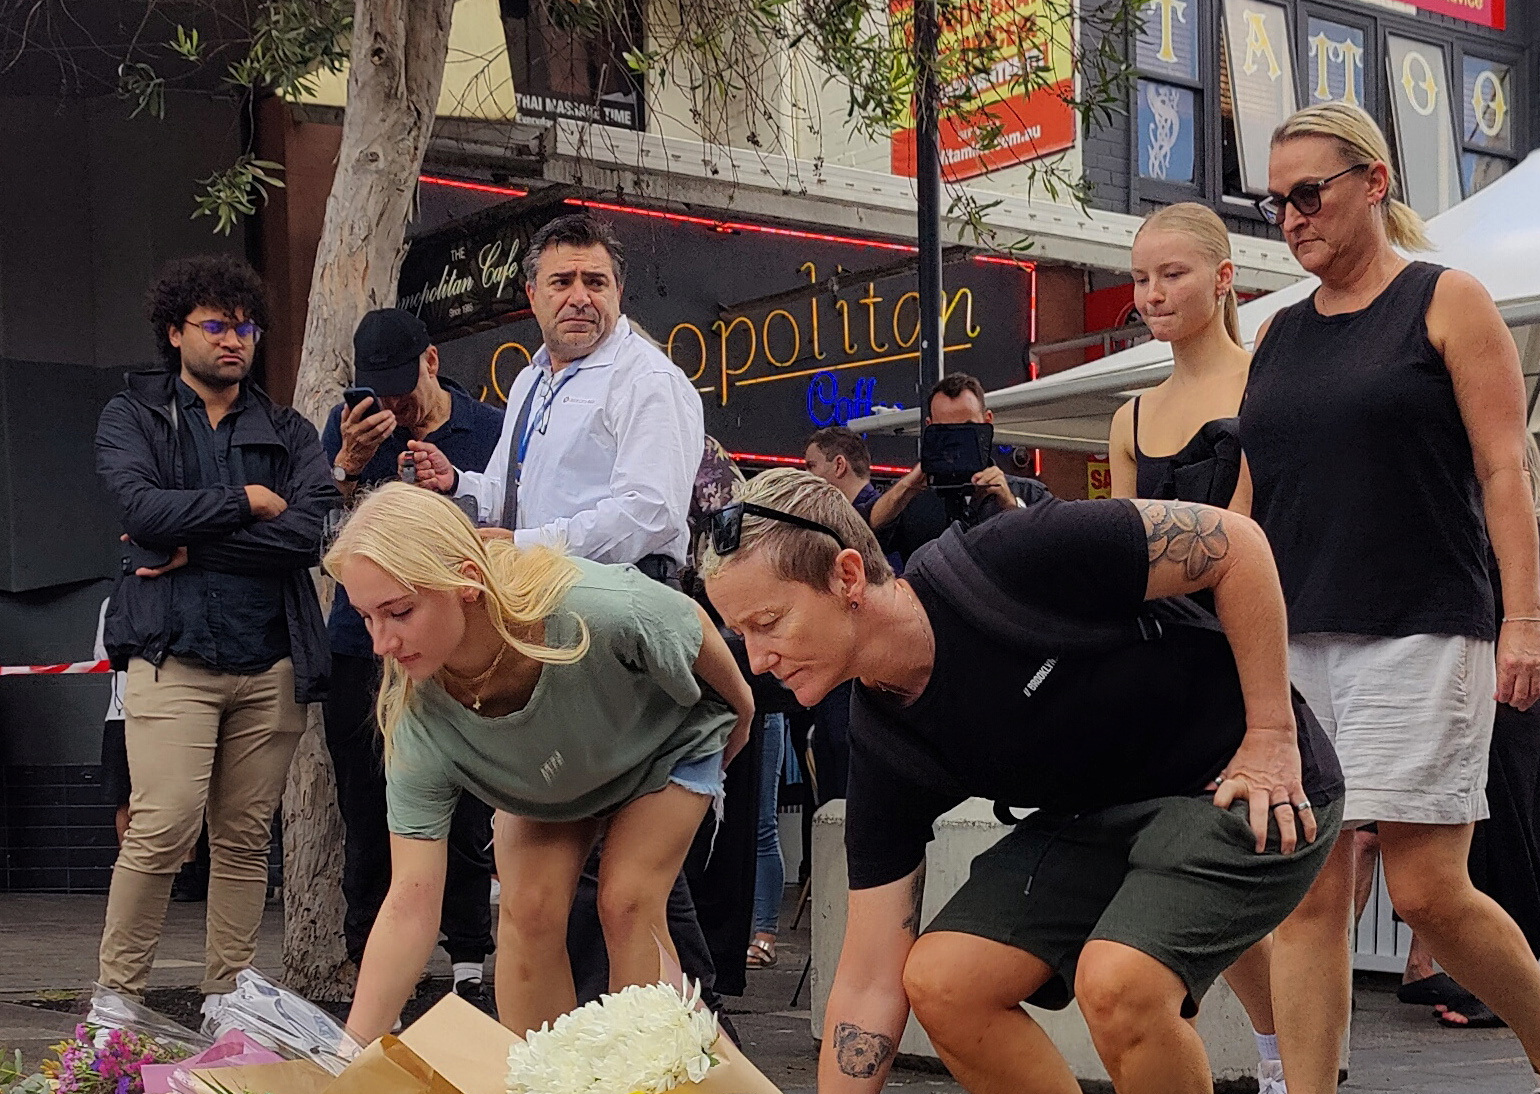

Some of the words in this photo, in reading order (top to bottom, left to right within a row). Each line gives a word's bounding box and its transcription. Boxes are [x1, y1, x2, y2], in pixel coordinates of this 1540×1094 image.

[1142, 0, 1506, 138] TATTOO
[603, 107, 632, 125] TIME
[450, 246, 466, 262] THE
